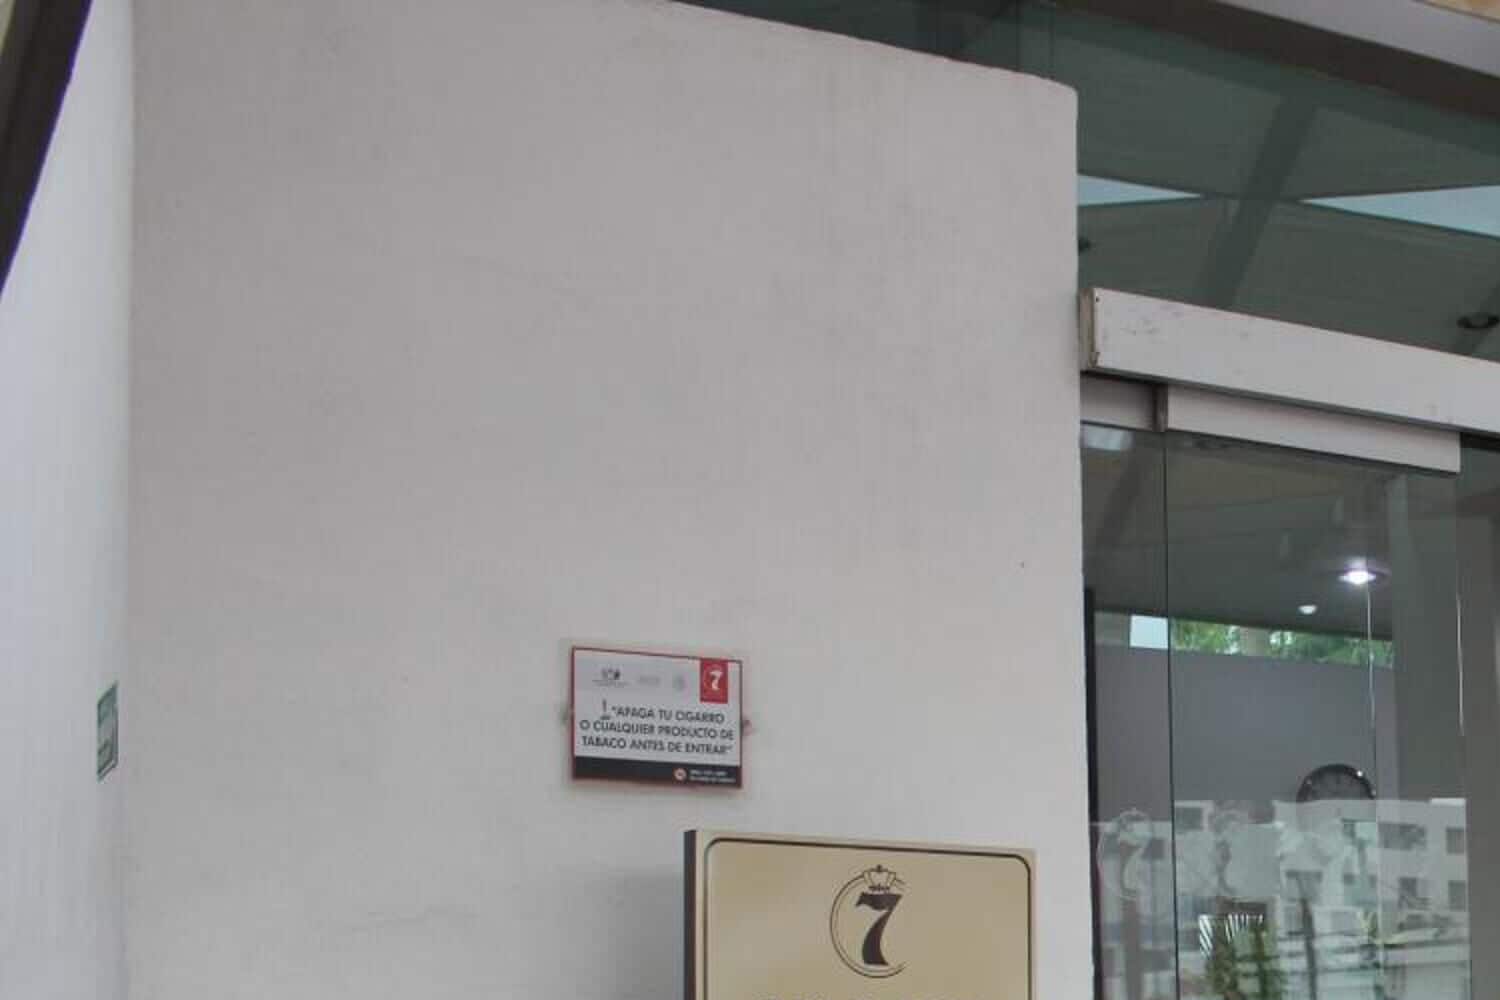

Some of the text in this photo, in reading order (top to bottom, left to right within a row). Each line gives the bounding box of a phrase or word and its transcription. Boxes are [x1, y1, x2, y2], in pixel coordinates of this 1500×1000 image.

[708, 670, 723, 690] 7
[659, 709, 673, 721] TU
[676, 710, 725, 725] CIGARRO
[579, 719, 734, 740] O CUALQUIER PRODUCTO DE
[582, 735, 627, 750] TABACO
[630, 738, 664, 752] ANTES
[668, 741, 682, 753] DE
[855, 891, 903, 966] 7
